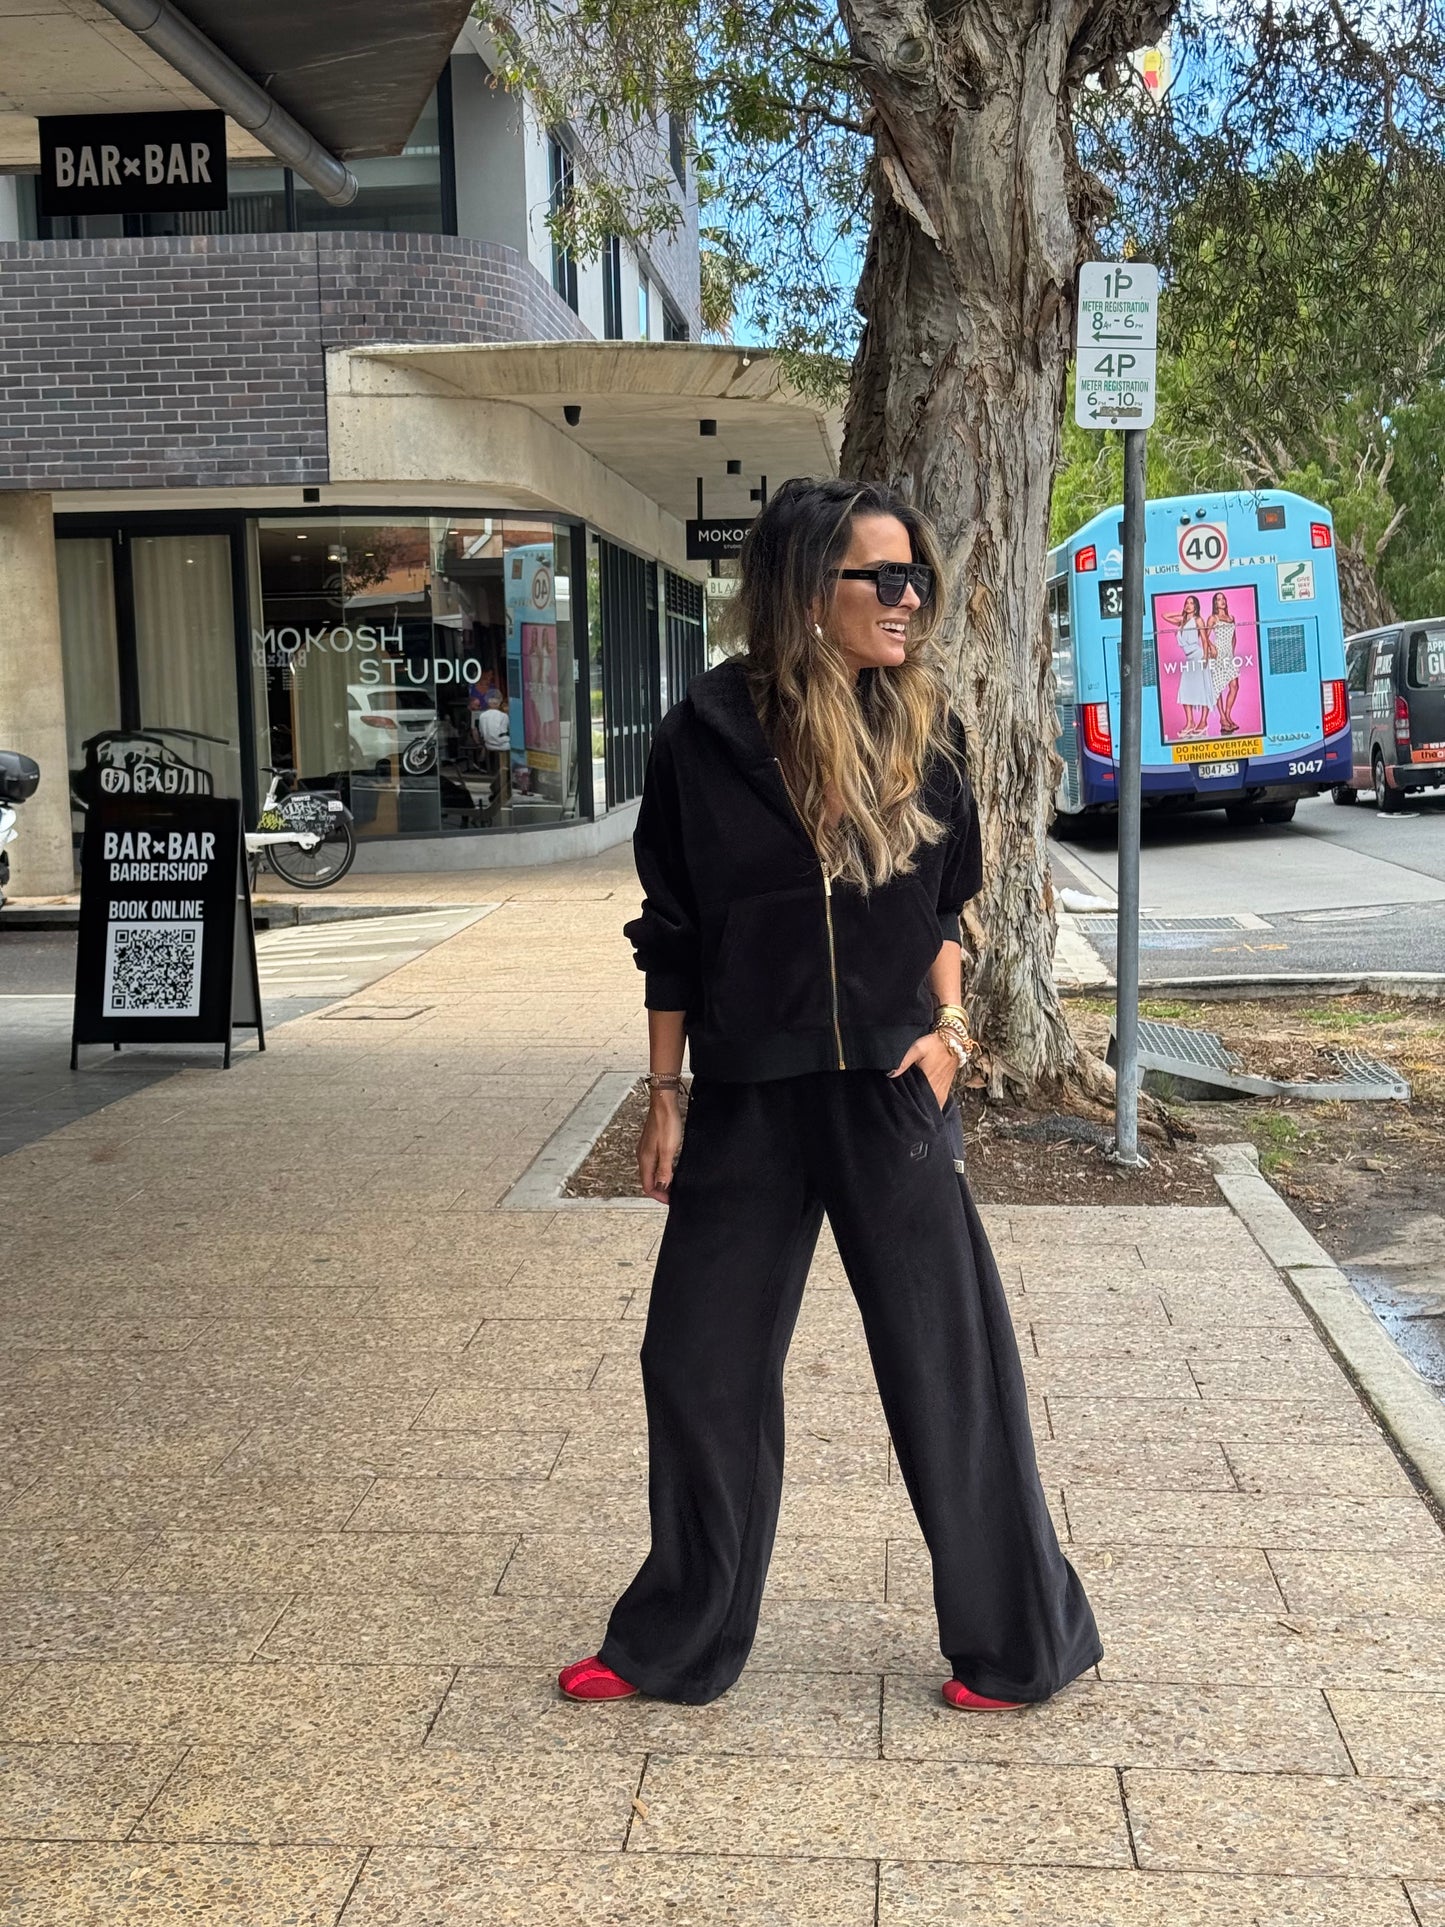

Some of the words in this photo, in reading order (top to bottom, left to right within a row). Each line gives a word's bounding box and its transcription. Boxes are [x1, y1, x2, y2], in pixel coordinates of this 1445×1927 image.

[1104, 274, 1133, 299] 1P
[1082, 301, 1103, 312] METER
[1104, 302, 1149, 313] REGISTRATION
[1094, 354, 1136, 378] 4P
[1081, 380, 1102, 391] METER
[1103, 380, 1149, 392] REGISTRATION
[1186, 535, 1222, 560] 40
[1155, 564, 1180, 574] LIGHTS
[1230, 555, 1276, 567] FLASH
[710, 582, 733, 594] BLA
[252, 626, 403, 653] MOKOSH
[359, 657, 483, 685] STUDIO
[1163, 659, 1216, 674] WHITE
[1223, 655, 1254, 668] FOX
[1176, 746, 1190, 754] DO
[1192, 744, 1209, 753] NOT
[1213, 739, 1259, 751] OVERTAKE
[1178, 752, 1218, 762] TURNING
[1220, 747, 1258, 758] VEHICLE
[1288, 760, 1324, 776] 3047
[110, 862, 208, 882] BARBERSHOP
[109, 900, 149, 919] BOOK
[151, 900, 204, 919] ONLINE
